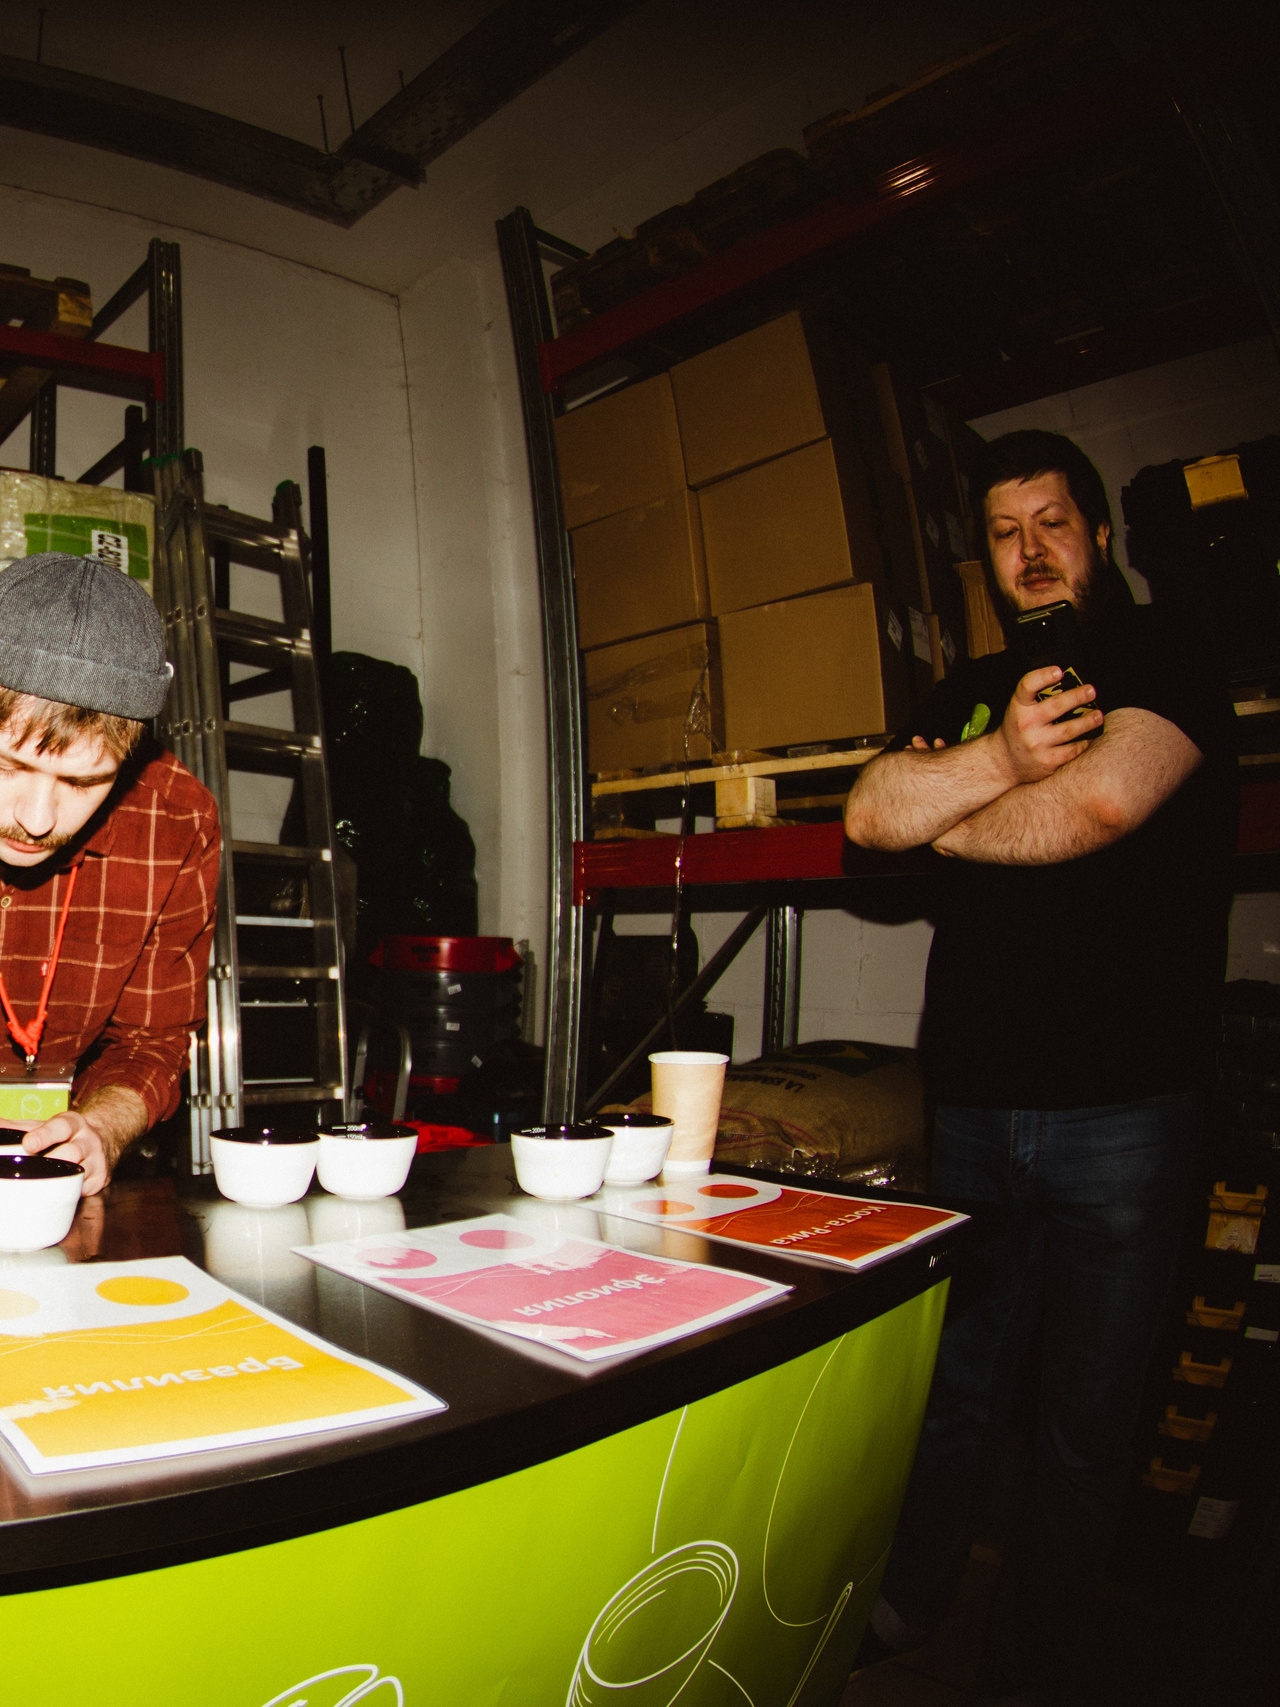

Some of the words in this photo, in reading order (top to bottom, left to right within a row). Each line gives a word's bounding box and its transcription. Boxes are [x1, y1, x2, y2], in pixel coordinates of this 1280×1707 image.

[97, 533, 122, 571] CZ-820
[768, 1204, 888, 1246] Коста-Рика
[512, 1273, 667, 1318] Эфиопия
[43, 1354, 306, 1402] Бразилия
